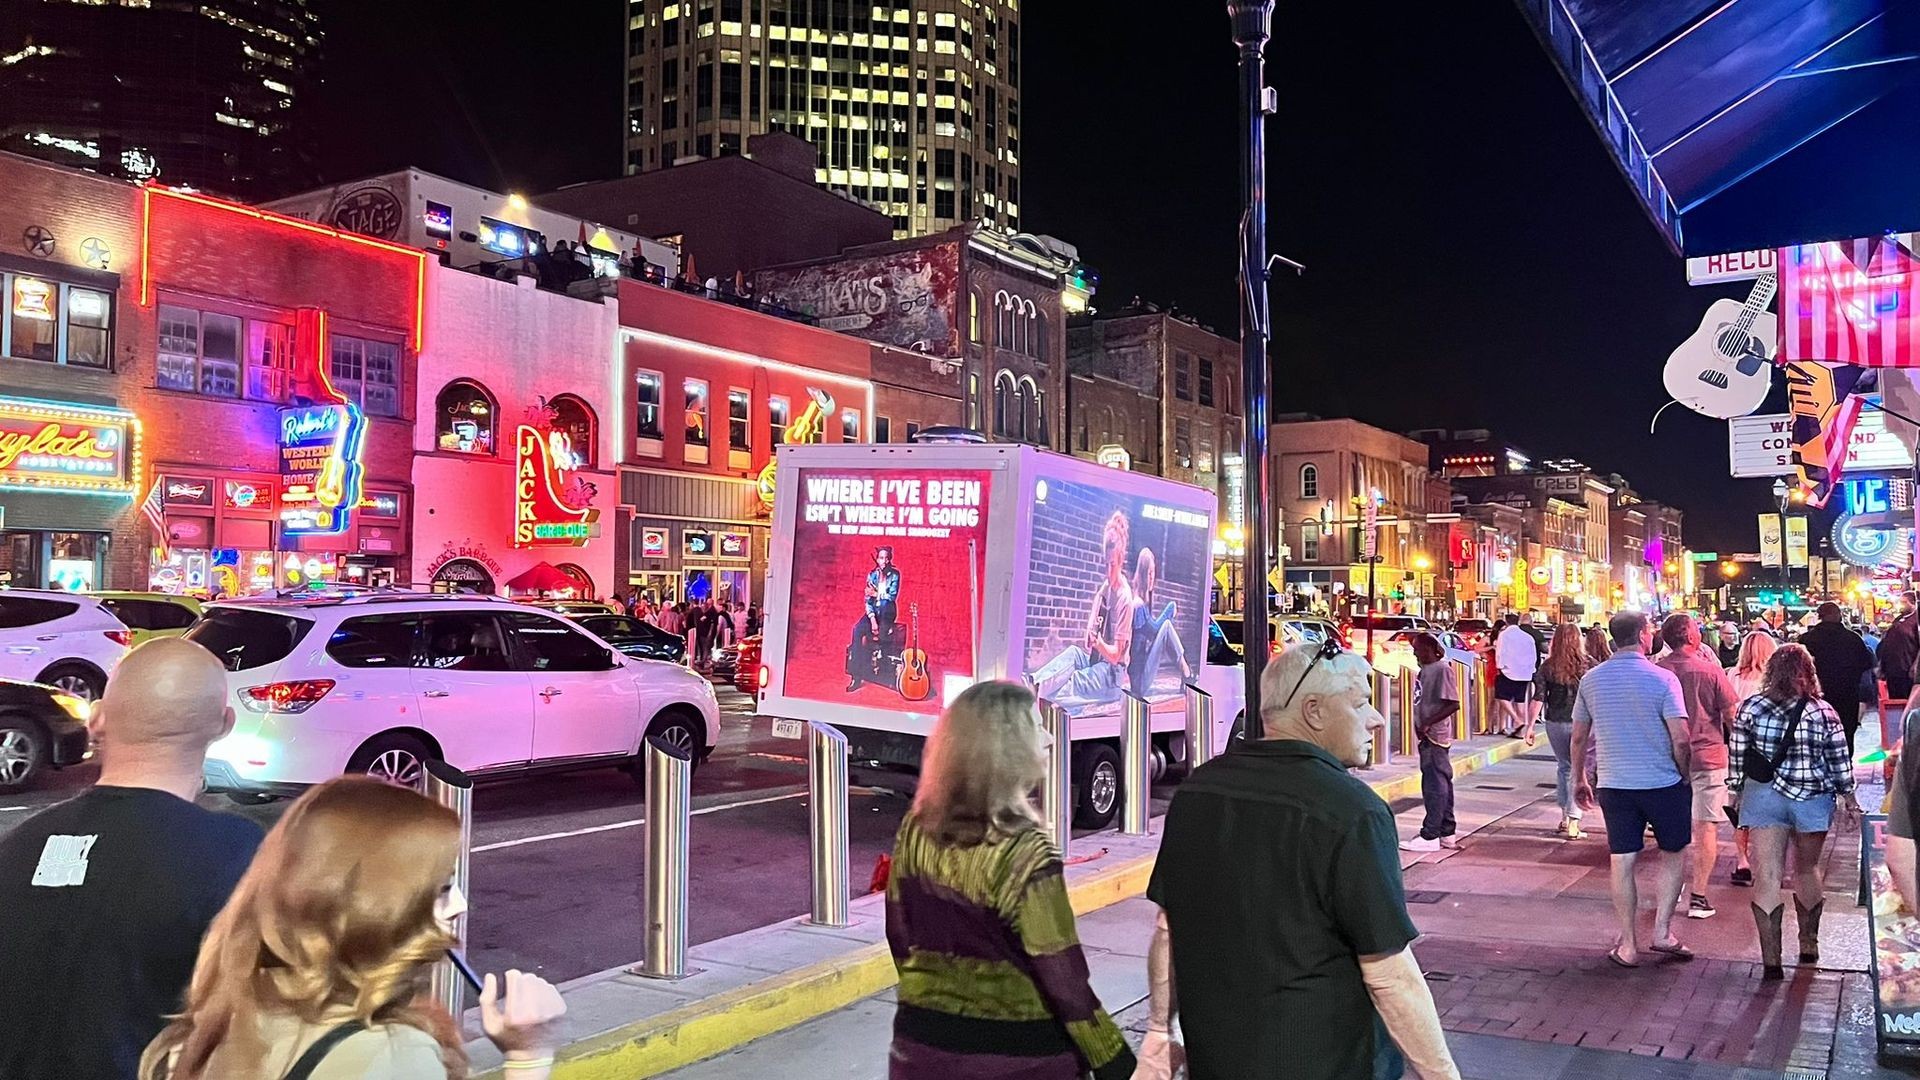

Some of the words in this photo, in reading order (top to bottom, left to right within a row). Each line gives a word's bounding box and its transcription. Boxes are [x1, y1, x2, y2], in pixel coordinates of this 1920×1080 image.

[282, 473, 314, 486] HOME
[519, 435, 537, 543] JACKS
[807, 479, 874, 503] WHERE
[880, 480, 921, 504] I'VE
[926, 481, 981, 505] BEEN
[805, 504, 842, 522] ISN'T
[844, 505, 895, 524] WHERE
[898, 506, 924, 525] I'M
[928, 508, 979, 527] GOING
[426, 548, 457, 578] JACK'S
